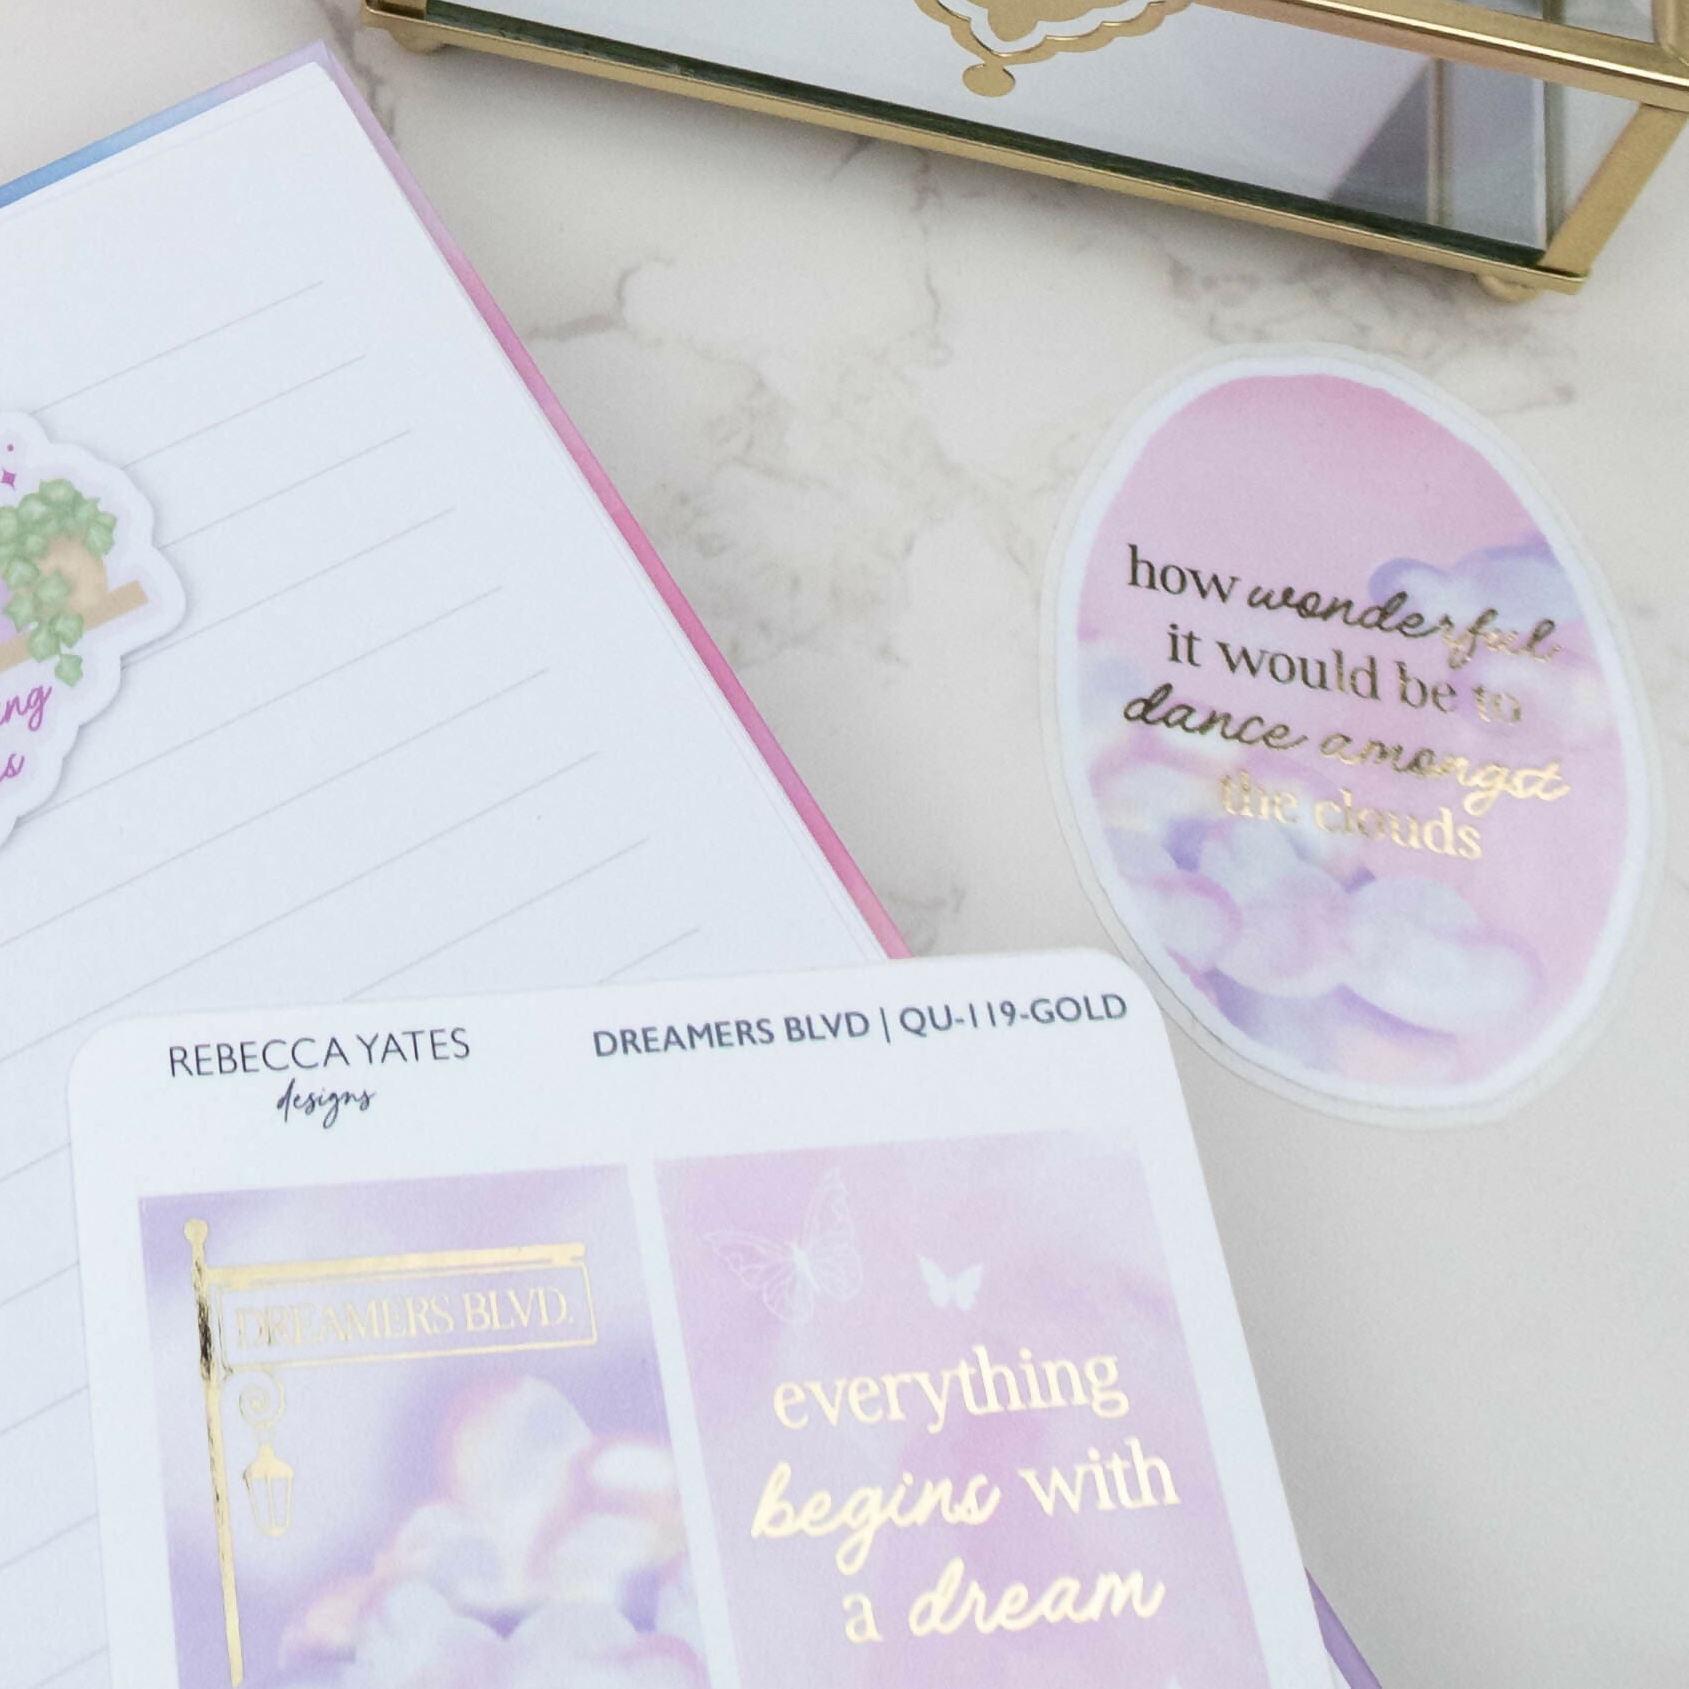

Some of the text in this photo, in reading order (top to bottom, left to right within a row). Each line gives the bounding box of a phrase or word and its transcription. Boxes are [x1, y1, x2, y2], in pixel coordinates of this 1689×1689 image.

[1126, 544, 1567, 670] how wonderful
[1167, 623, 1522, 725] it would be to
[1123, 682, 1571, 816] dance amongst
[1221, 768, 1483, 860] the clouds
[169, 1027, 472, 1077] REBECCA YATES
[592, 1017, 775, 1057] DREAMERS
[784, 1010, 871, 1042] BLVD
[898, 993, 1129, 1034] QU-119-GOLD
[276, 1078, 378, 1129] designs
[235, 1286, 575, 1351] DREAMERS BLVD.
[773, 1344, 1130, 1434] everything
[750, 1435, 1181, 1576] begins with
[842, 1556, 1167, 1644] a dream
